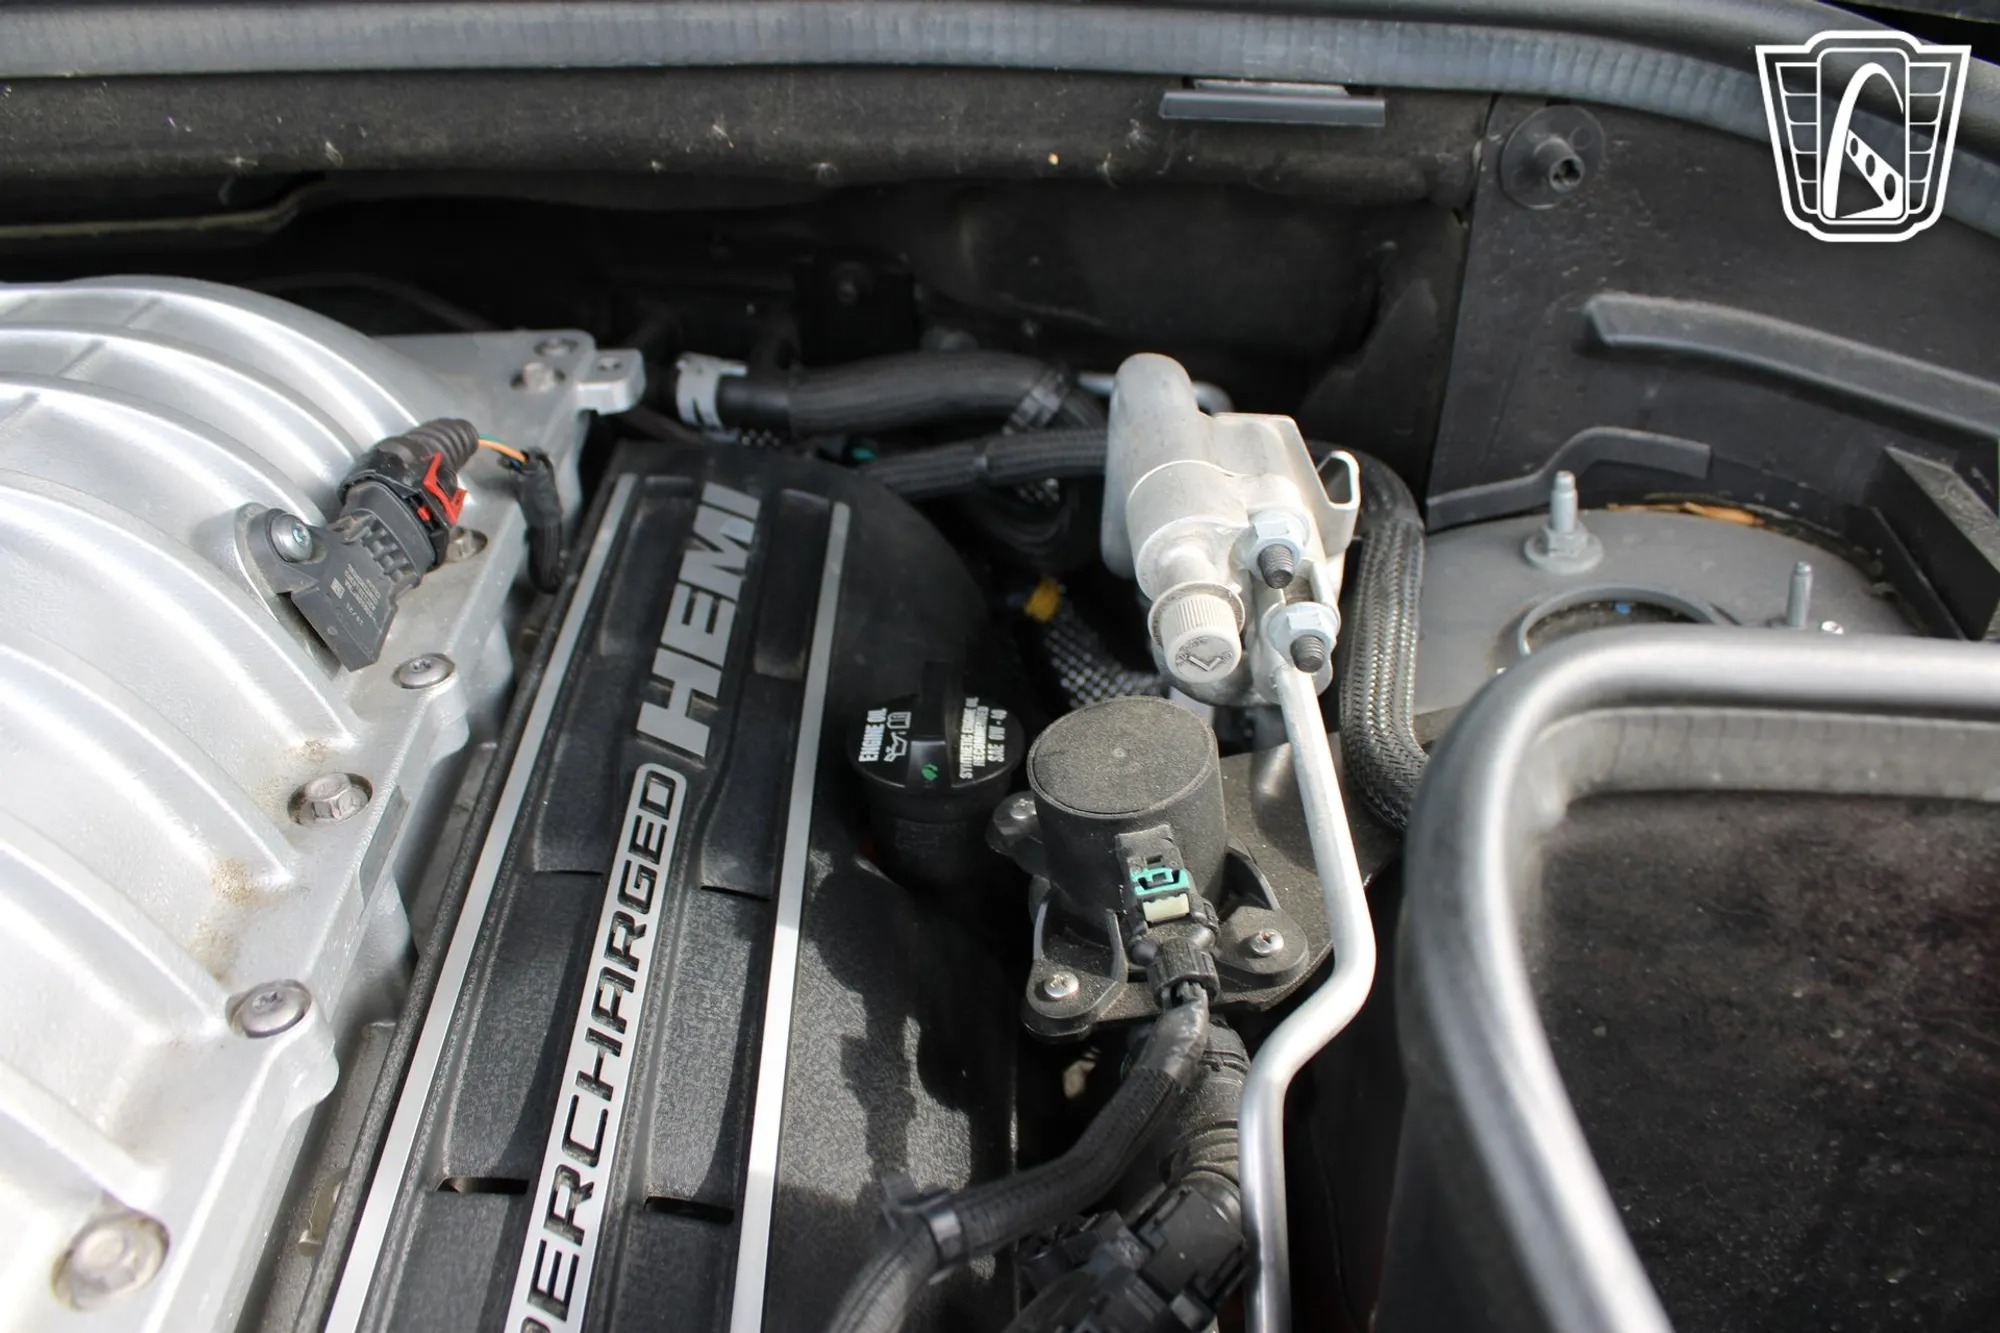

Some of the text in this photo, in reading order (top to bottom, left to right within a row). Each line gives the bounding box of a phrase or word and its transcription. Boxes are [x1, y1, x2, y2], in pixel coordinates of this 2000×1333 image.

[636, 480, 762, 758] HEMI
[858, 707, 887, 762] ENGINE OIL
[959, 732, 974, 779] SYNTHETIC
[987, 743, 1006, 763] SAE
[521, 770, 676, 1333] ERCHARGED
